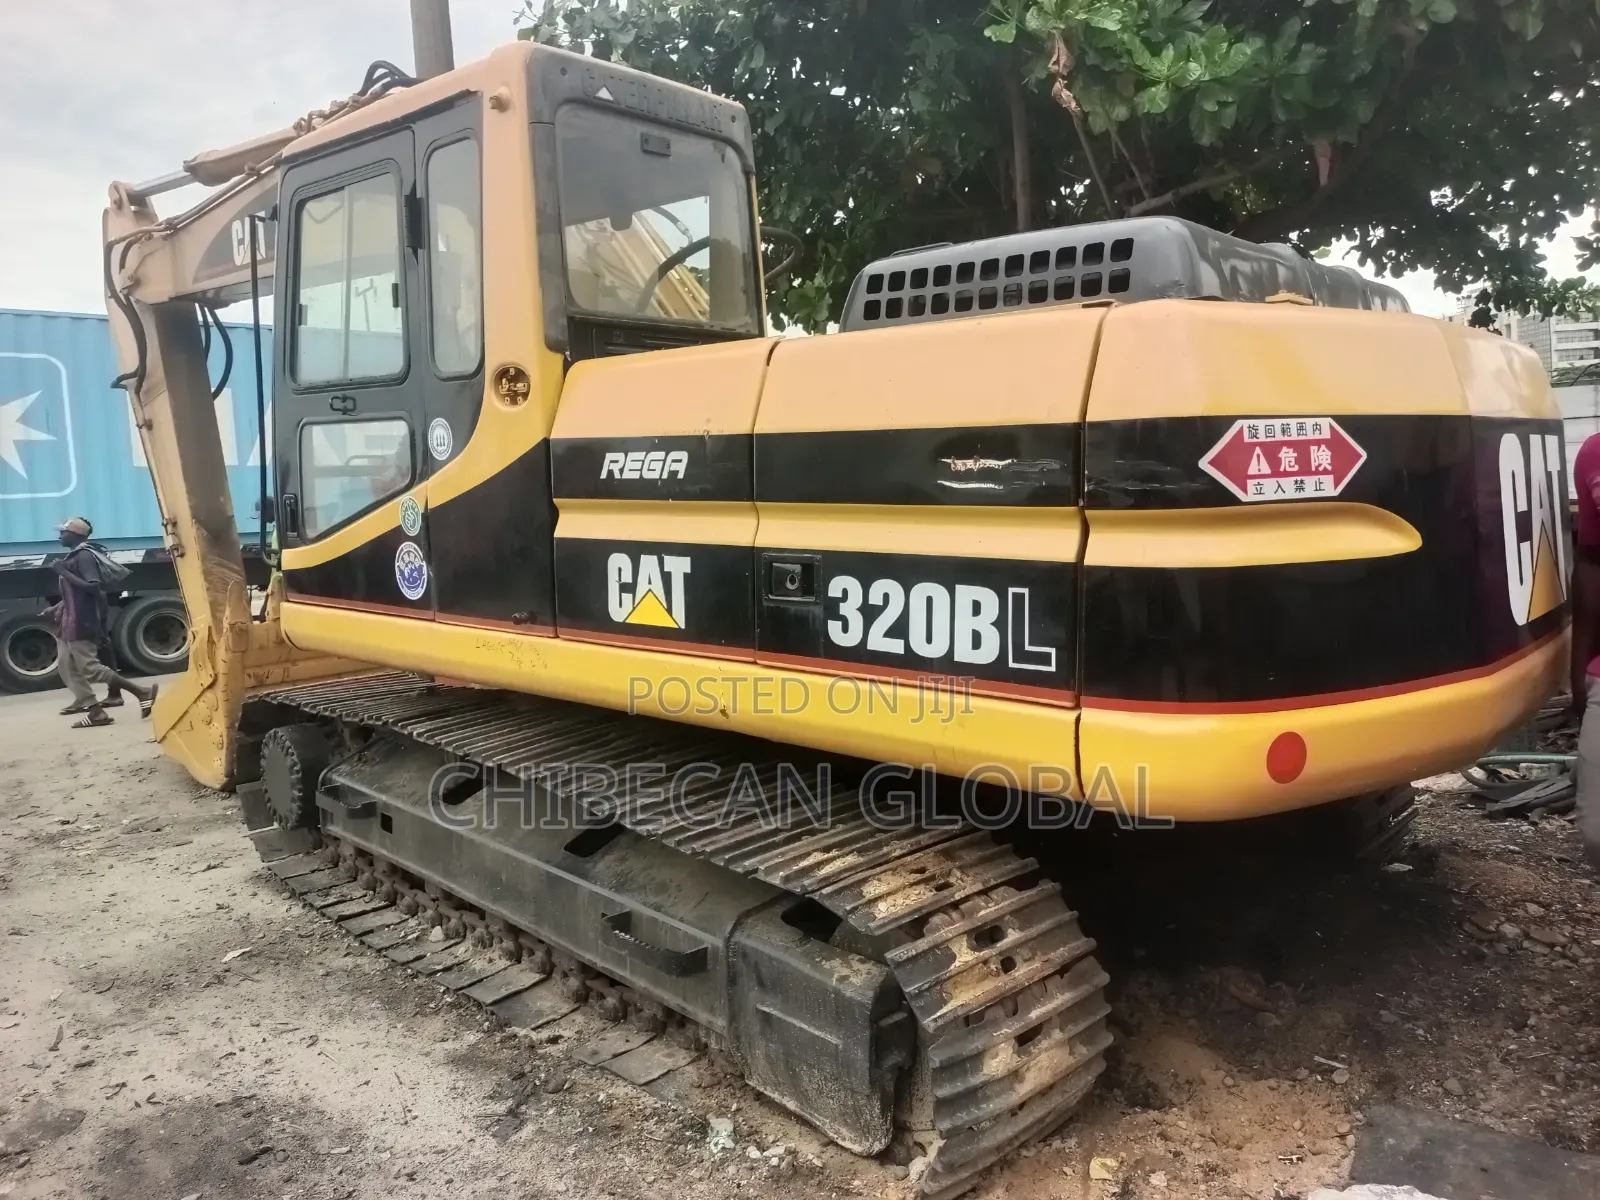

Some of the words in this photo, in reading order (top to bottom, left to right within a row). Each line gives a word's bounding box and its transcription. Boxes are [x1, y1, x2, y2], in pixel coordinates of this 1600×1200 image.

[1247, 421, 1322, 440] 旋回範囲内
[600, 451, 689, 479] REGA
[1278, 444, 1332, 472] 危険
[1253, 478, 1325, 496] 立入禁止
[1499, 433, 1567, 626] CAT
[607, 553, 692, 629] CAT
